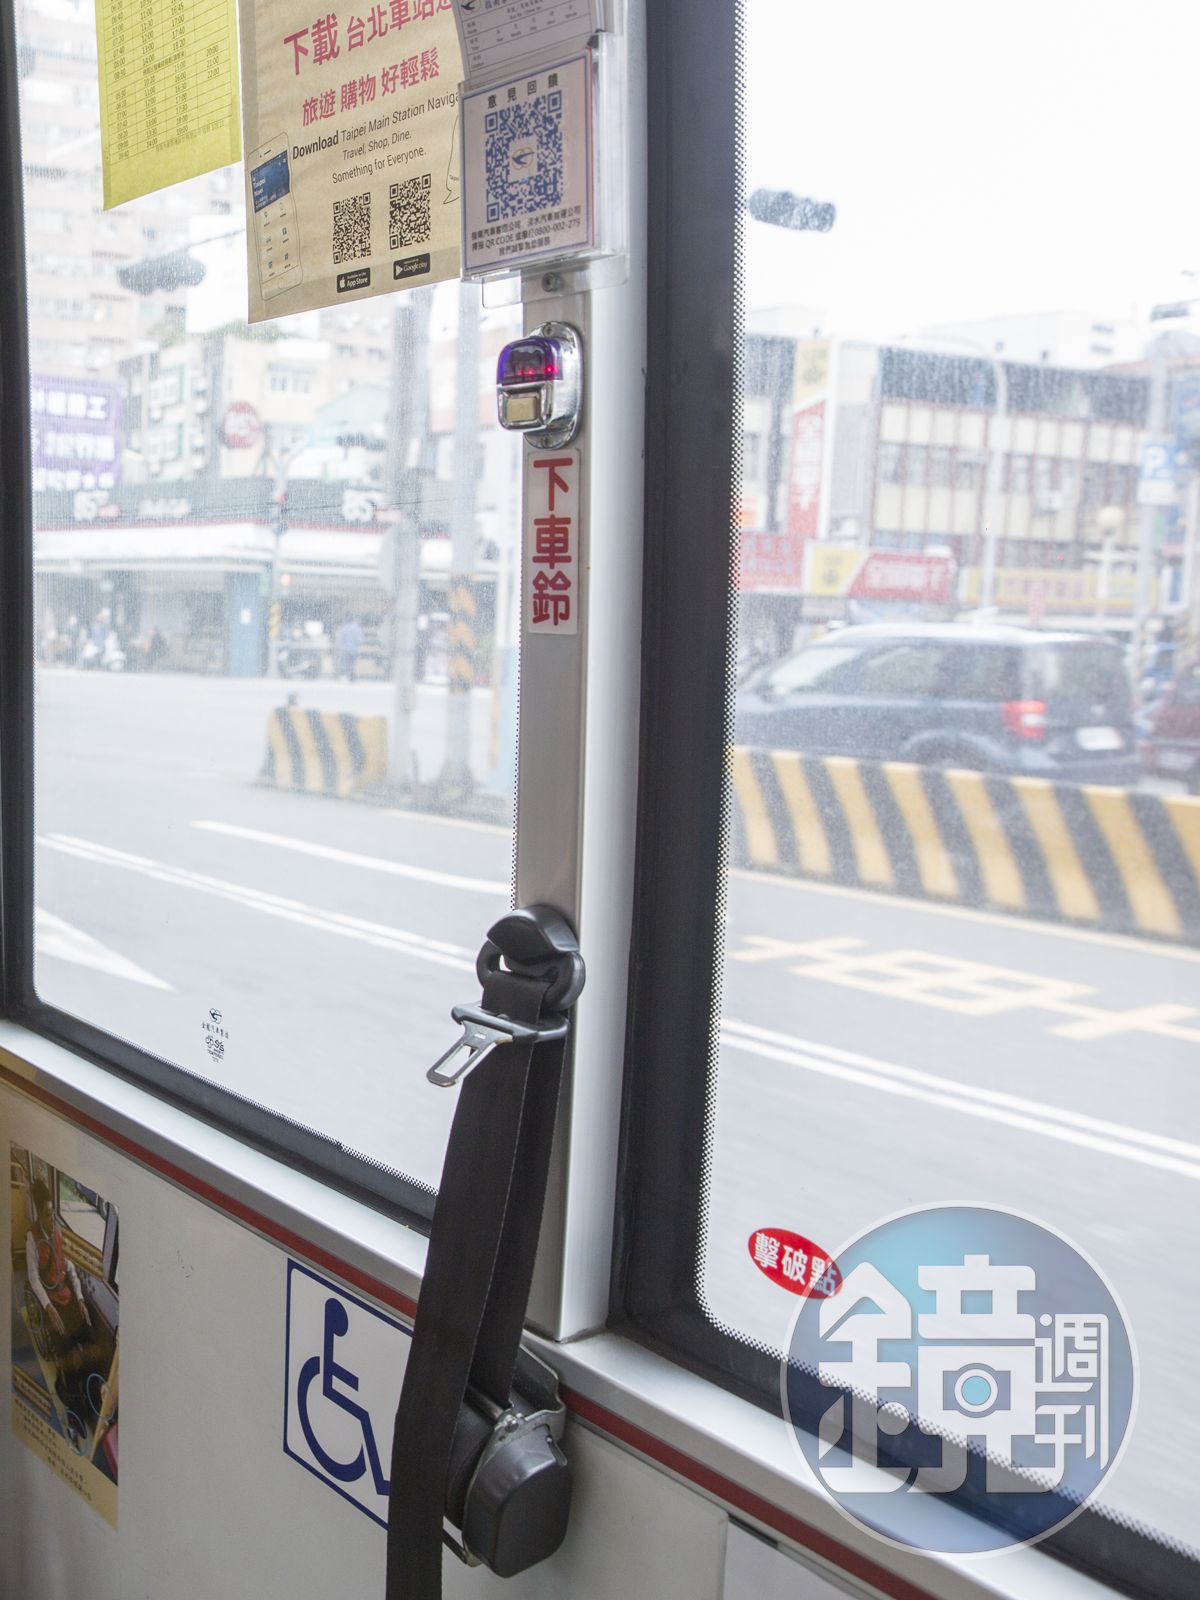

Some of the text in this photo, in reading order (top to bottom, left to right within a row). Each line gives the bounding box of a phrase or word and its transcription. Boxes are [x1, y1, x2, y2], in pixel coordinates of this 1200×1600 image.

[206, 56, 219, 68] 21:00
[283, 12, 341, 76] 下載
[207, 67, 220, 79] 22:00
[302, 47, 440, 127] 旅遊 購物 好輕鬆
[292, 130, 339, 160] Download
[340, 121, 367, 144] Taipei
[368, 115, 390, 134] Main
[392, 103, 425, 125] Station
[342, 129, 412, 161] Travel, Shop, Dine.
[332, 146, 427, 184] Something for Everyone.
[533, 457, 573, 626] 下車鈴
[754, 1232, 837, 1297] 擊破點
